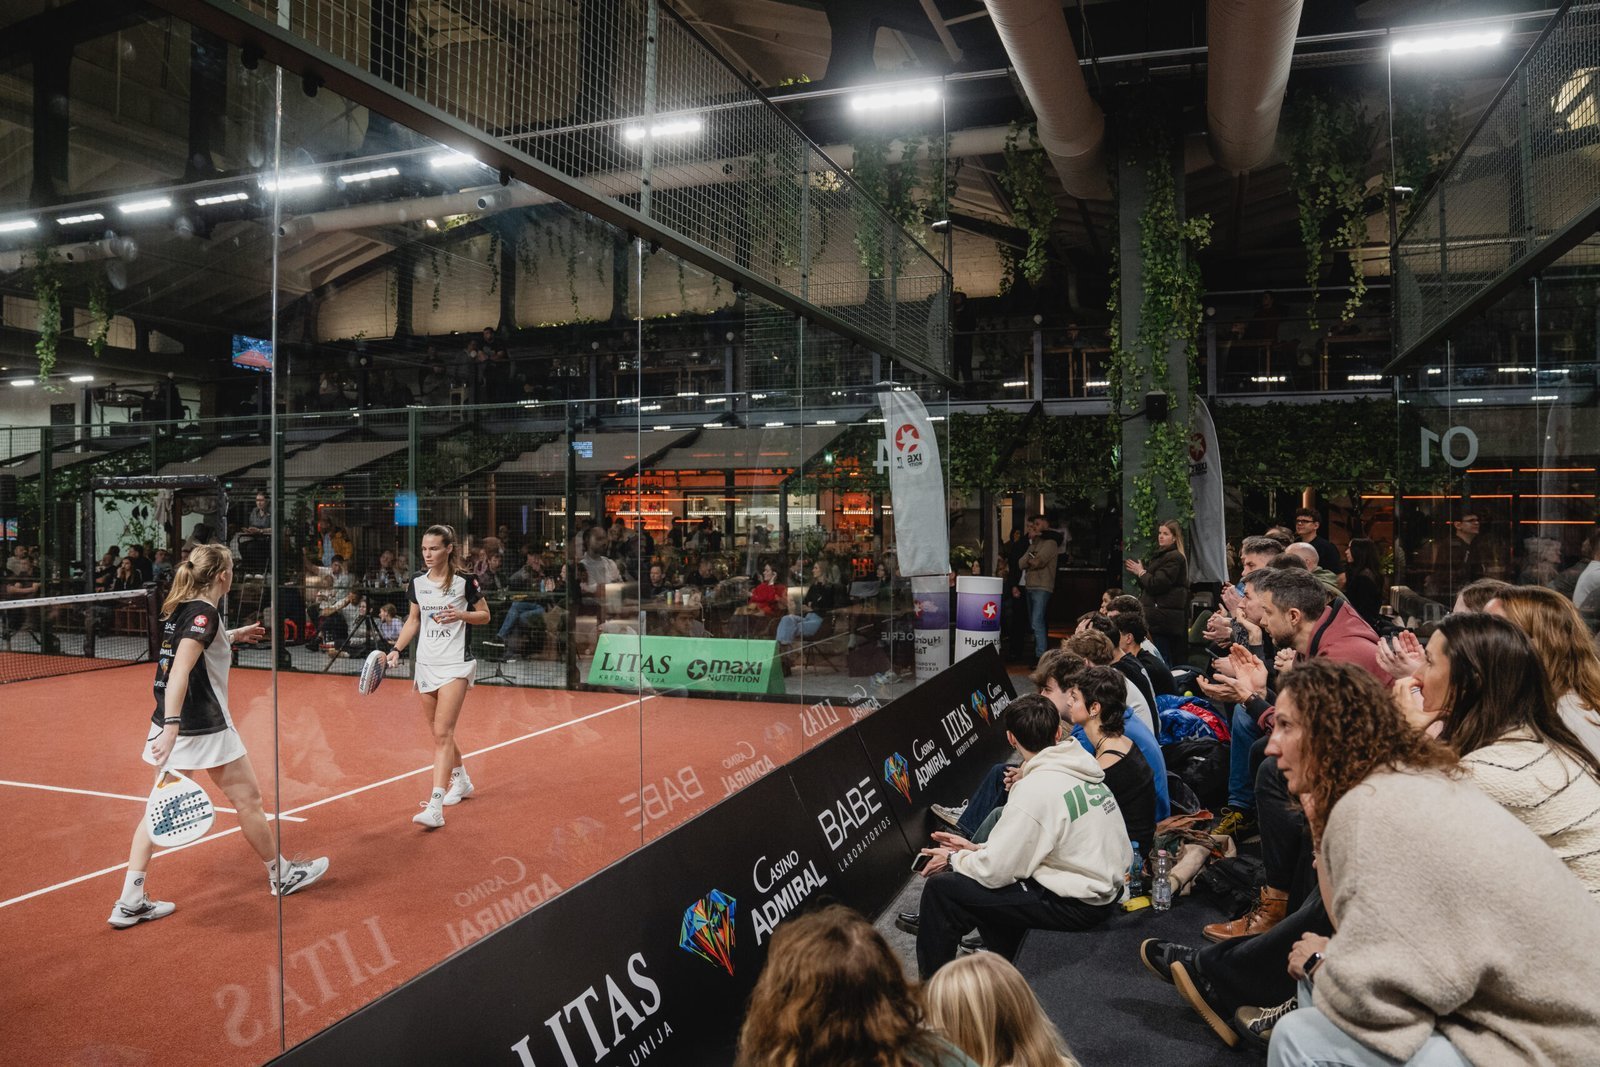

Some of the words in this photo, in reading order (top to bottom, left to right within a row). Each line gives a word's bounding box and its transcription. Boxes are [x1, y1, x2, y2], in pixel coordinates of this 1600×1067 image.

[426, 629, 451, 638] LITAS
[599, 652, 672, 675] LITAS
[707, 673, 761, 684] NUTRITION
[709, 659, 763, 676] maxi
[940, 703, 974, 746] LITAS
[912, 738, 935, 762] CASINO
[914, 747, 952, 792] ADMIRAL
[817, 775, 883, 852] BABE
[837, 816, 892, 873] LABORATORIOS
[752, 849, 800, 894] CASINO
[750, 859, 829, 947] ADMIRAL
[628, 1021, 674, 1067] UNIJA
